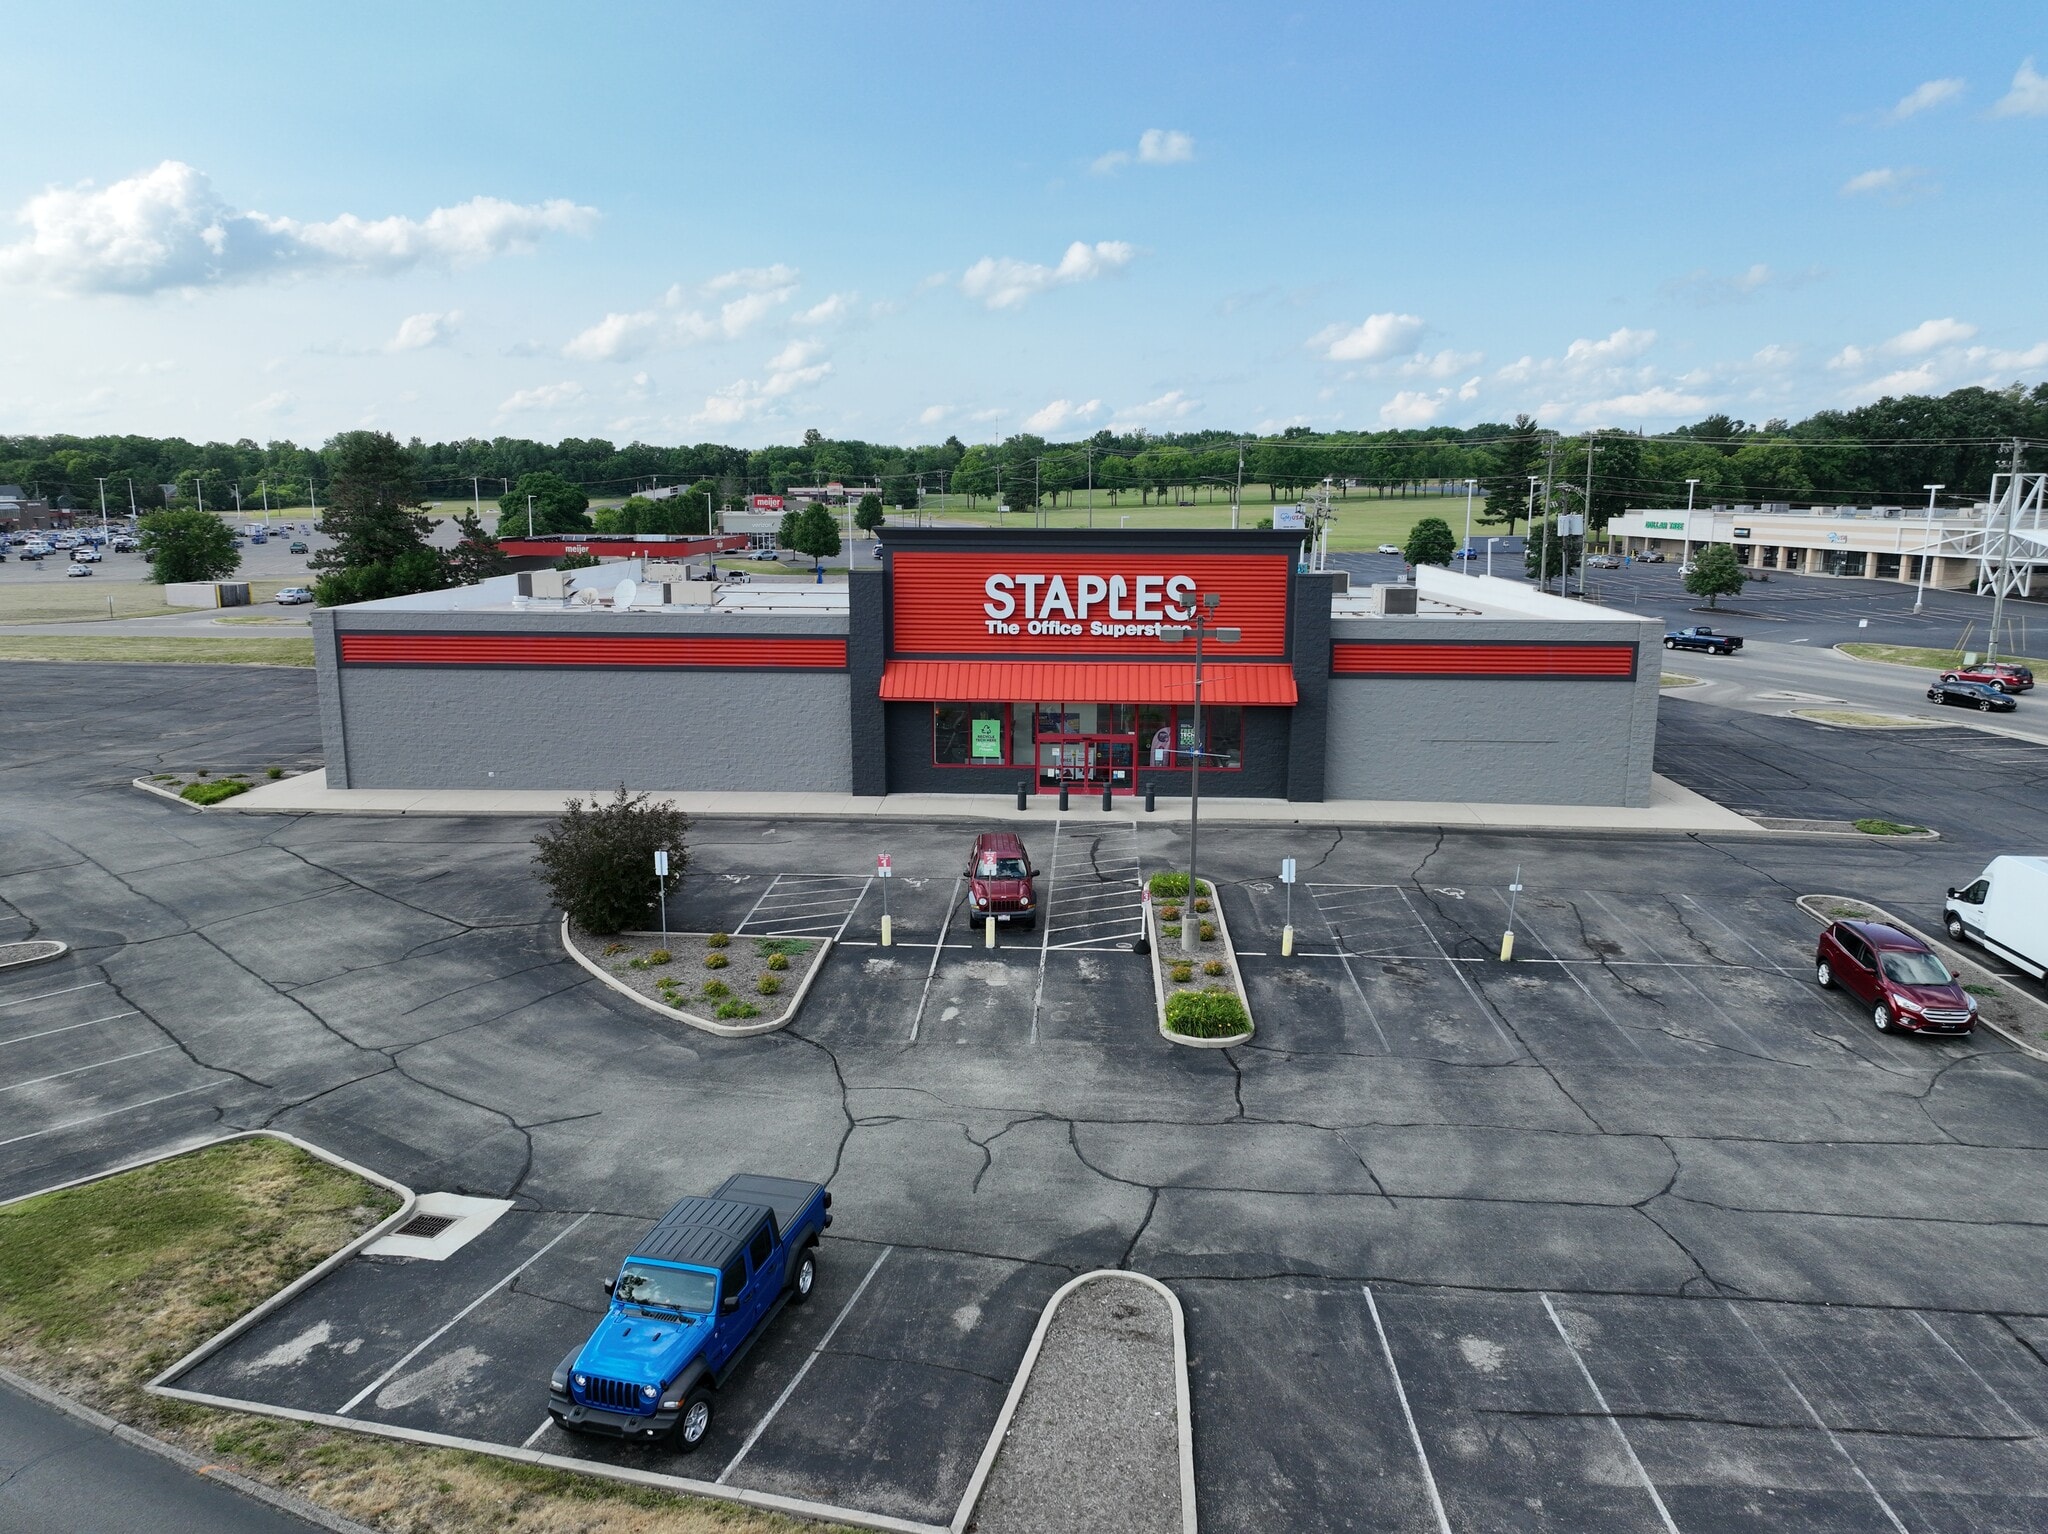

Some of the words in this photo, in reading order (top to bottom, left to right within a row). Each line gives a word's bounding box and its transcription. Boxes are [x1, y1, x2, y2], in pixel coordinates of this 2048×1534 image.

[757, 497, 780, 507] meijer
[1645, 521, 1667, 529] DOLLAR
[1669, 522, 1684, 530] TREE
[565, 544, 589, 554] meijer
[983, 573, 1197, 621] STAPLES
[985, 620, 1020, 635] The
[1027, 620, 1083, 636] Office
[1090, 620, 1192, 638] Superst
[881, 859, 887, 867] 1
[986, 857, 994, 865] 2
